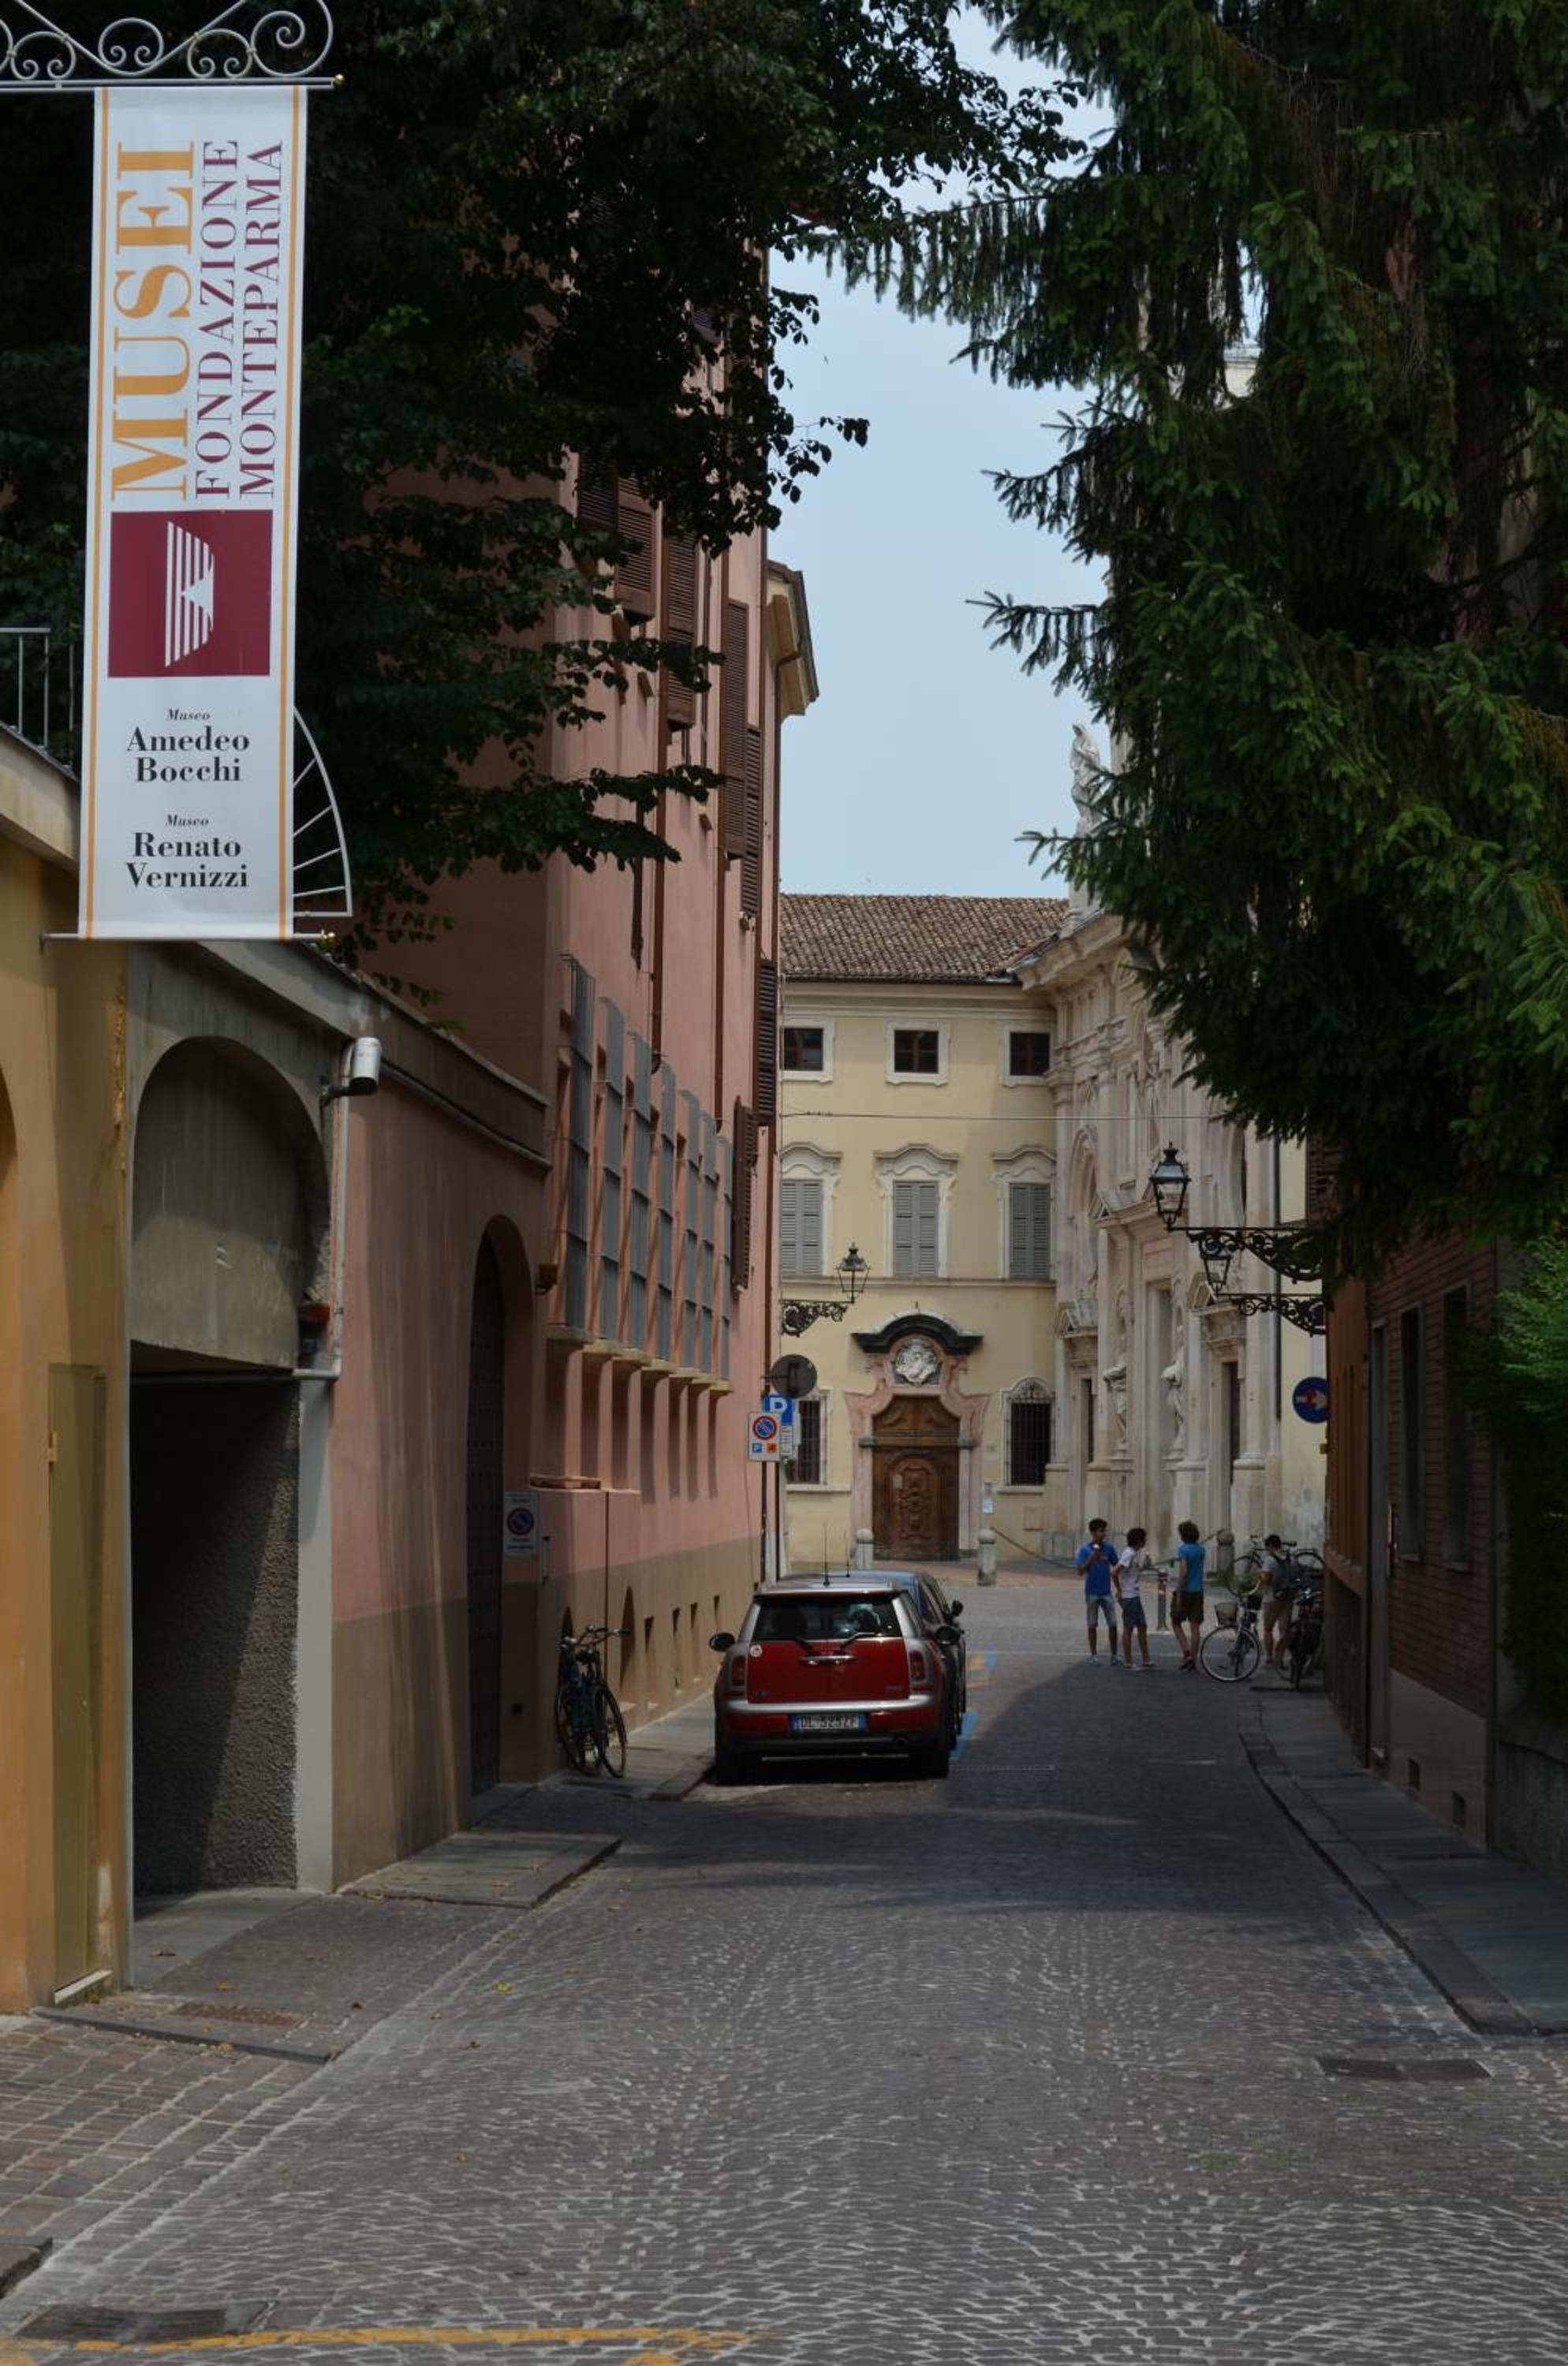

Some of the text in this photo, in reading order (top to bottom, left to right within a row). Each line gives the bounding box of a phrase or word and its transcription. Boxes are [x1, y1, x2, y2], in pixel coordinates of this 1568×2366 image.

[110, 142, 195, 501] MUSEI
[195, 140, 238, 499] FONDAZIONE
[239, 140, 282, 499] MONTEPARMA
[166, 708, 211, 721] Museo
[127, 726, 250, 752] Amedeo
[136, 756, 241, 783] Bocchi
[166, 814, 209, 827] Museo
[133, 832, 242, 857] Renato
[126, 863, 248, 888] Vernizzi
[770, 1397, 787, 1413] P
